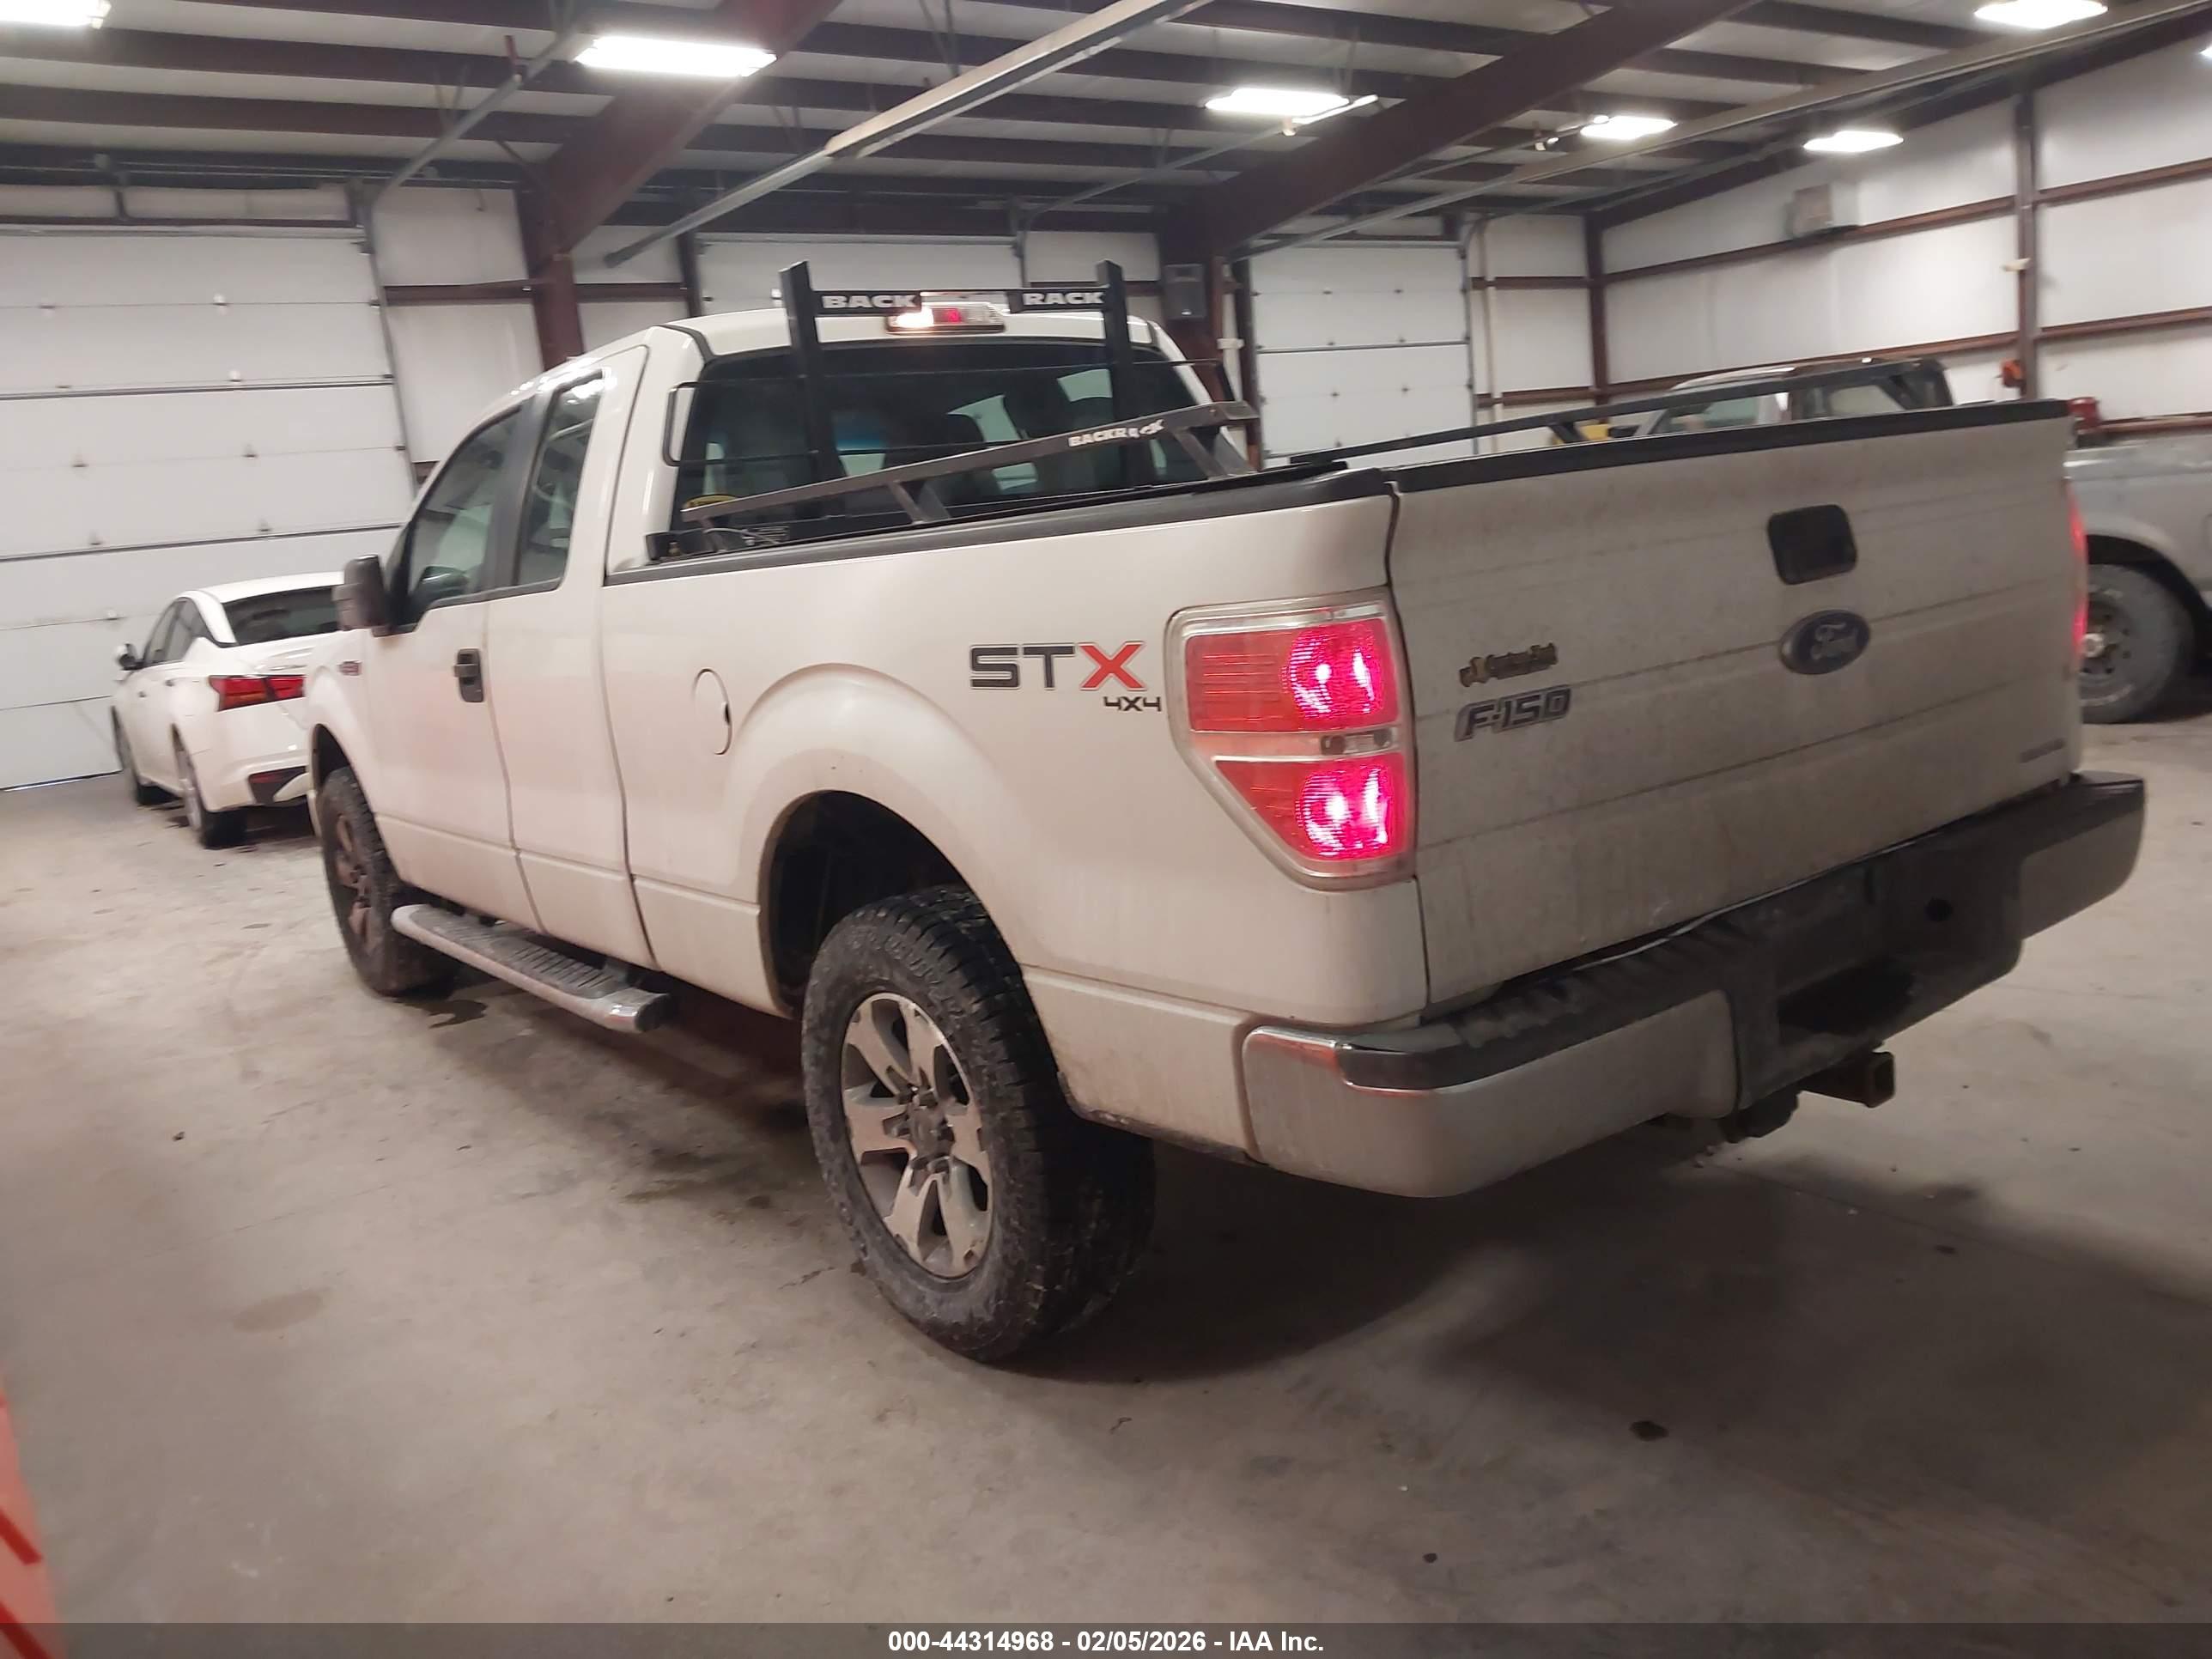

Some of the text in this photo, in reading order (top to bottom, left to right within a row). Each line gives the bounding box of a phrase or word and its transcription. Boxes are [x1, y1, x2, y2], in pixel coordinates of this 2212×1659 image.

[822, 291, 1104, 309] BACK RACK
[970, 641, 1146, 691] STX
[1455, 684, 1571, 742] F-150
